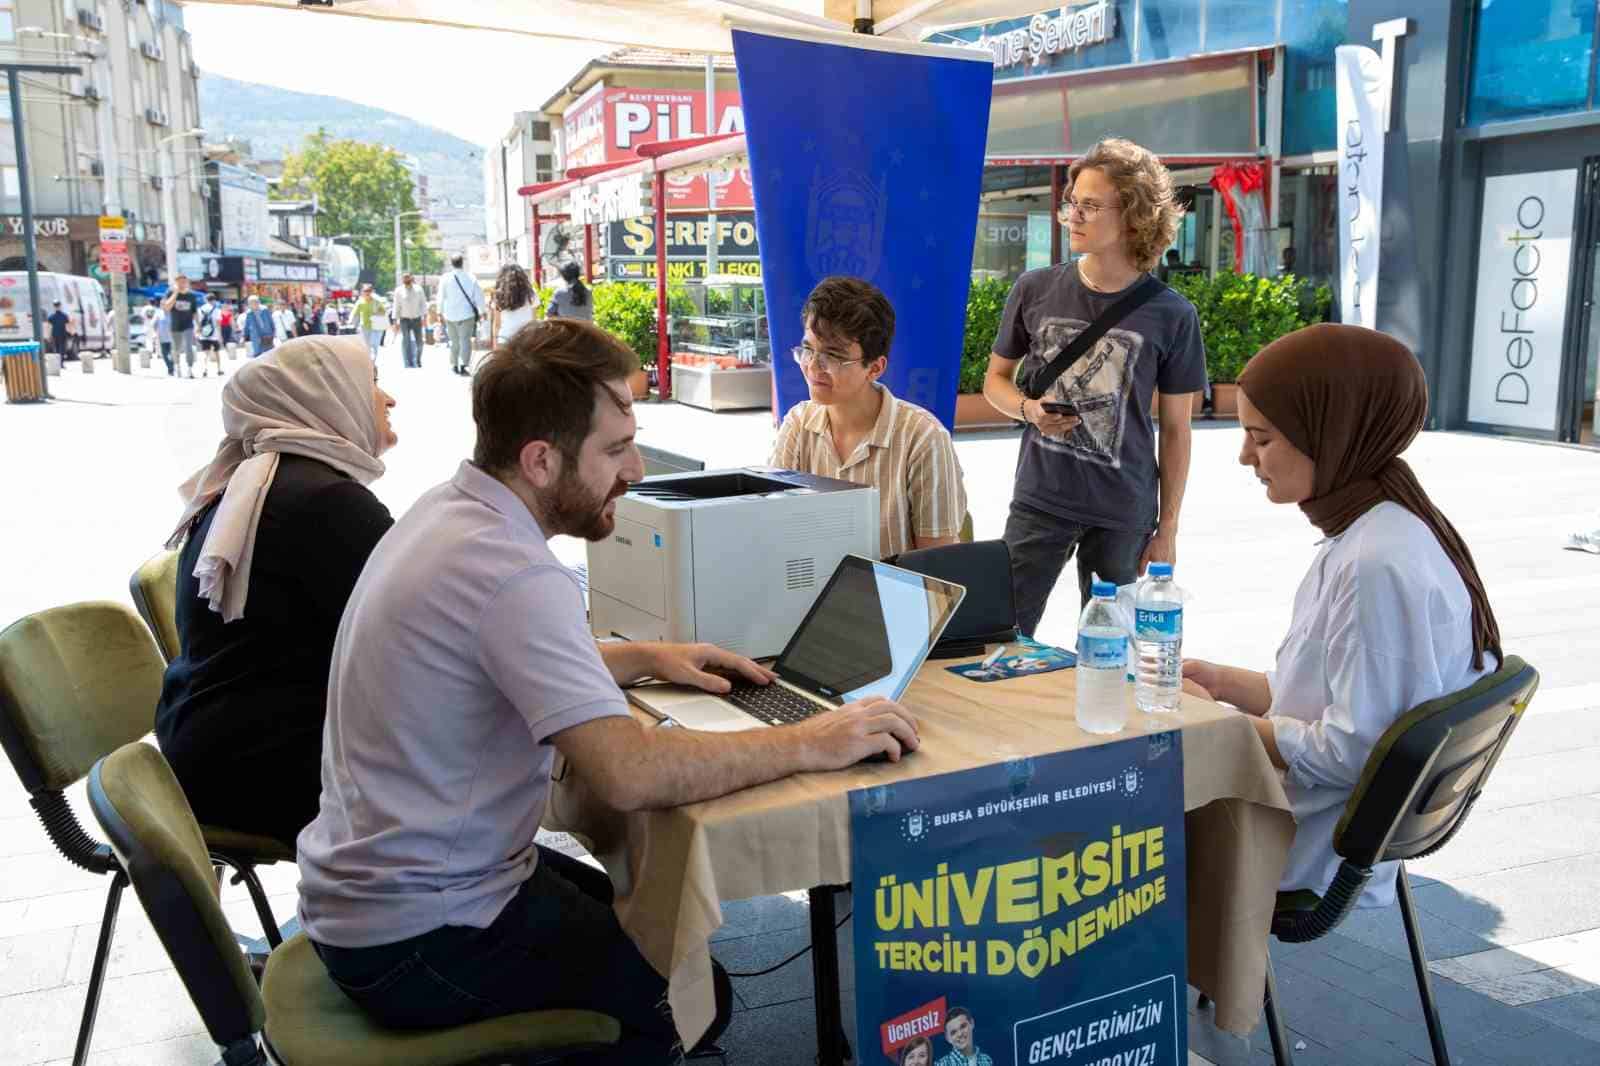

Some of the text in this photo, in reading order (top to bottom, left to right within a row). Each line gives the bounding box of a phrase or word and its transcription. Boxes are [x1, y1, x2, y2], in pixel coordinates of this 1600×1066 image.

[8, 217, 70, 236] YKUB
[623, 216, 758, 255] ŞEREFO
[646, 261, 694, 276] HNKİ
[1495, 195, 1545, 405] DeFacto
[934, 778, 1116, 827] BURSA BÜYÜKŞEHİR BELEDİYESİ
[875, 825, 1165, 932] ÜNİVERSİTE
[874, 876, 1167, 979] TERCİH DÖNEMİNDE
[887, 1008, 940, 1044] ÜCRETSİZ
[1029, 998, 1163, 1065] GENÇLERİMİZİN
